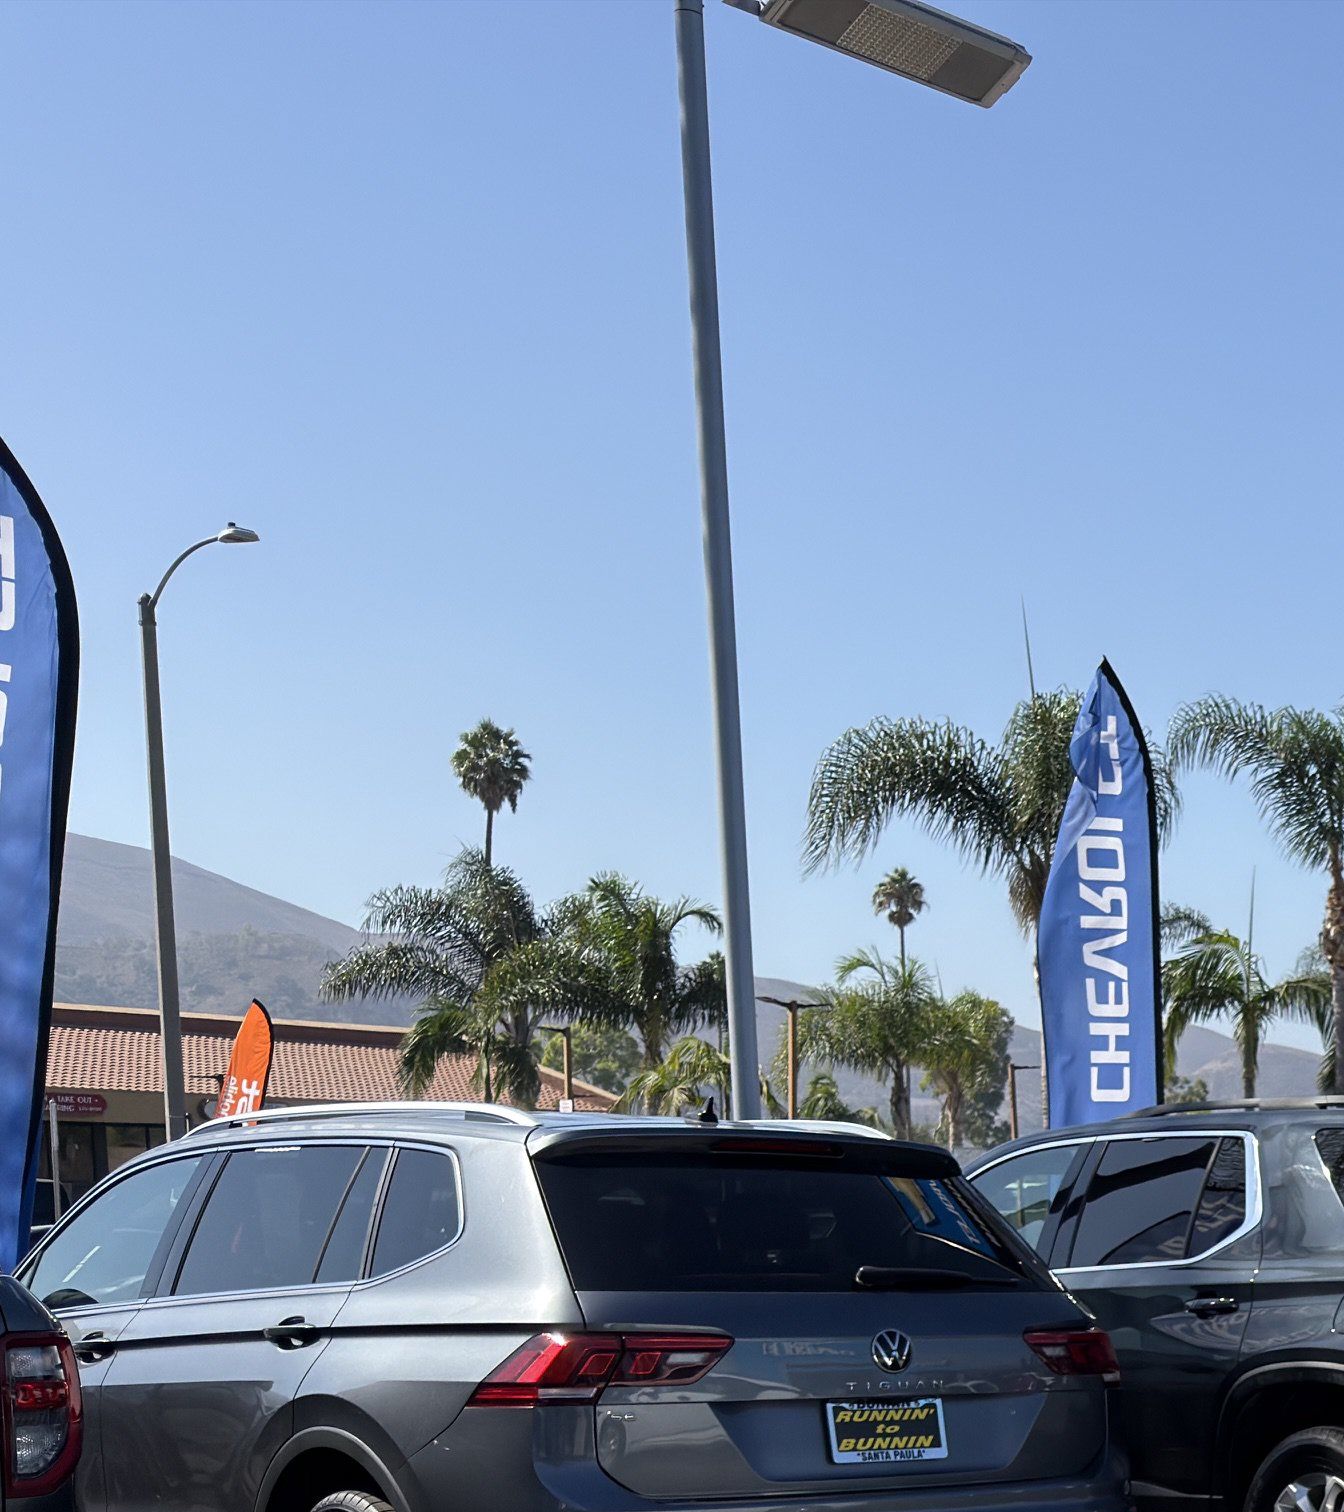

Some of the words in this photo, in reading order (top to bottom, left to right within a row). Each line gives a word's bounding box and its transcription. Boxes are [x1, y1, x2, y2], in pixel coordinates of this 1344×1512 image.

[844, 1379, 944, 1392] TIGUAN
[835, 1408, 935, 1423] RUNNIN'
[875, 1424, 900, 1434] to
[838, 1435, 934, 1451] BUNNIN
